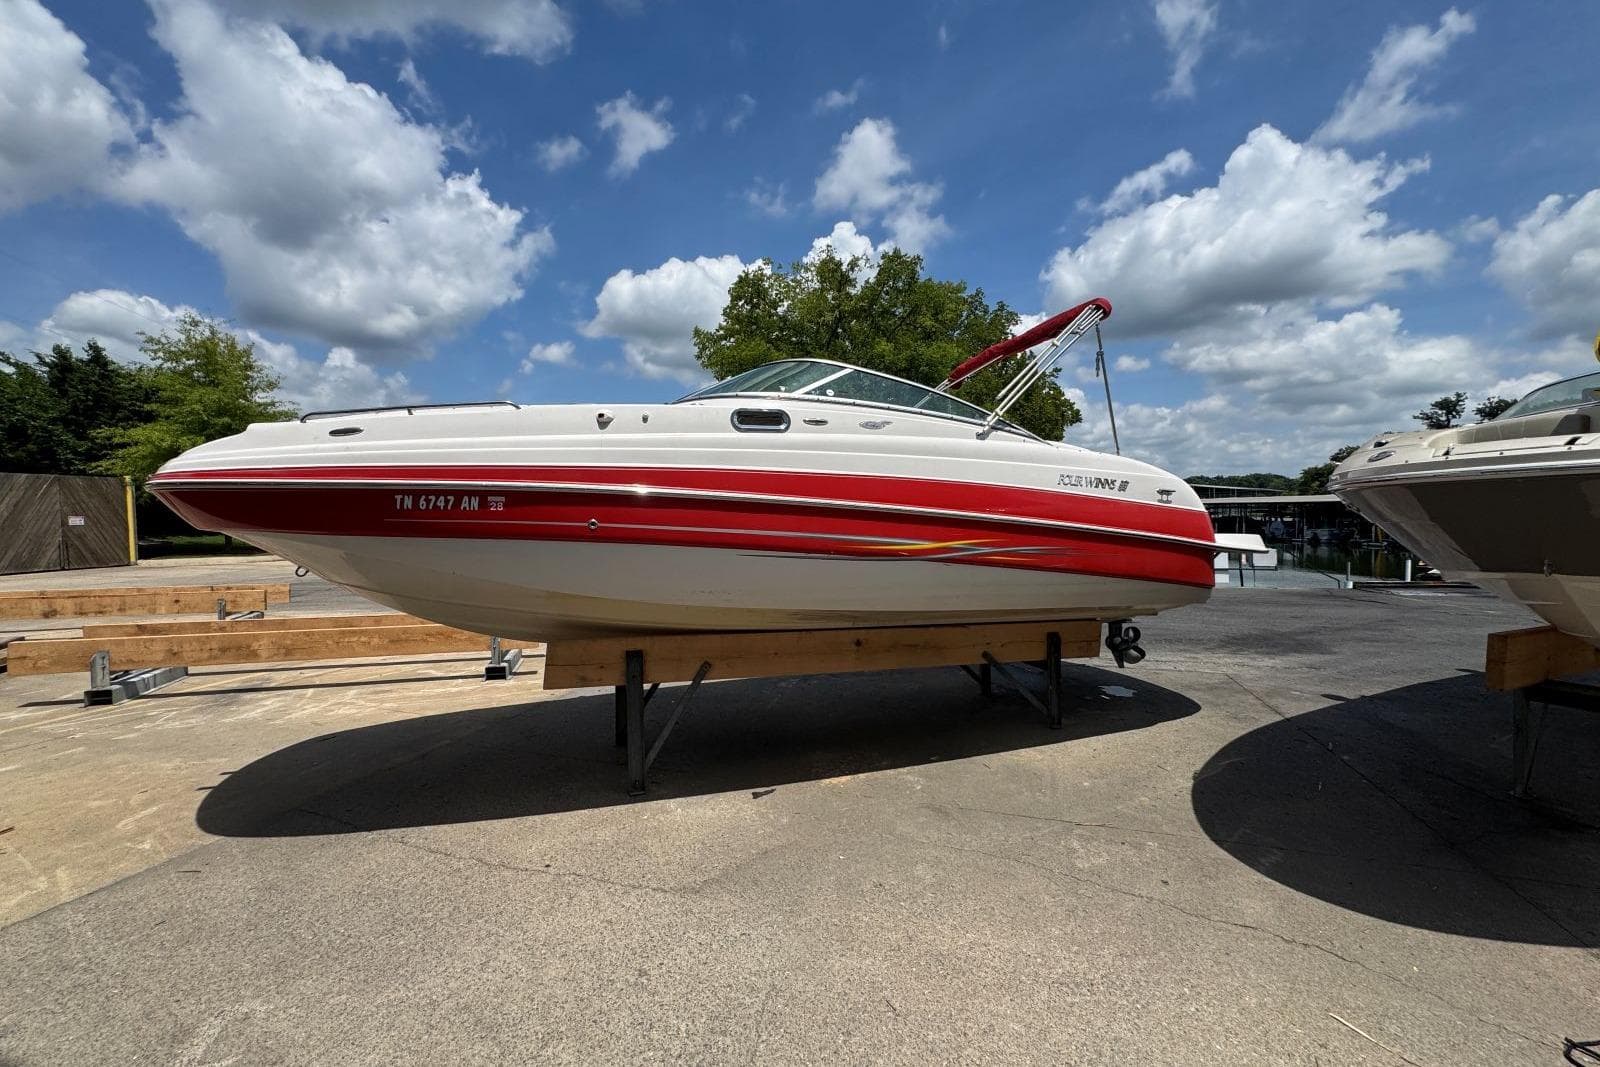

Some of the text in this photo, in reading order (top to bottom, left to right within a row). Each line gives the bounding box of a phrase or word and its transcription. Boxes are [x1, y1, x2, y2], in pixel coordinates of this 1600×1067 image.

[1084, 476, 1117, 491] WINNS
[394, 494, 479, 511] TN 6747 AN
[489, 501, 504, 511] 28
